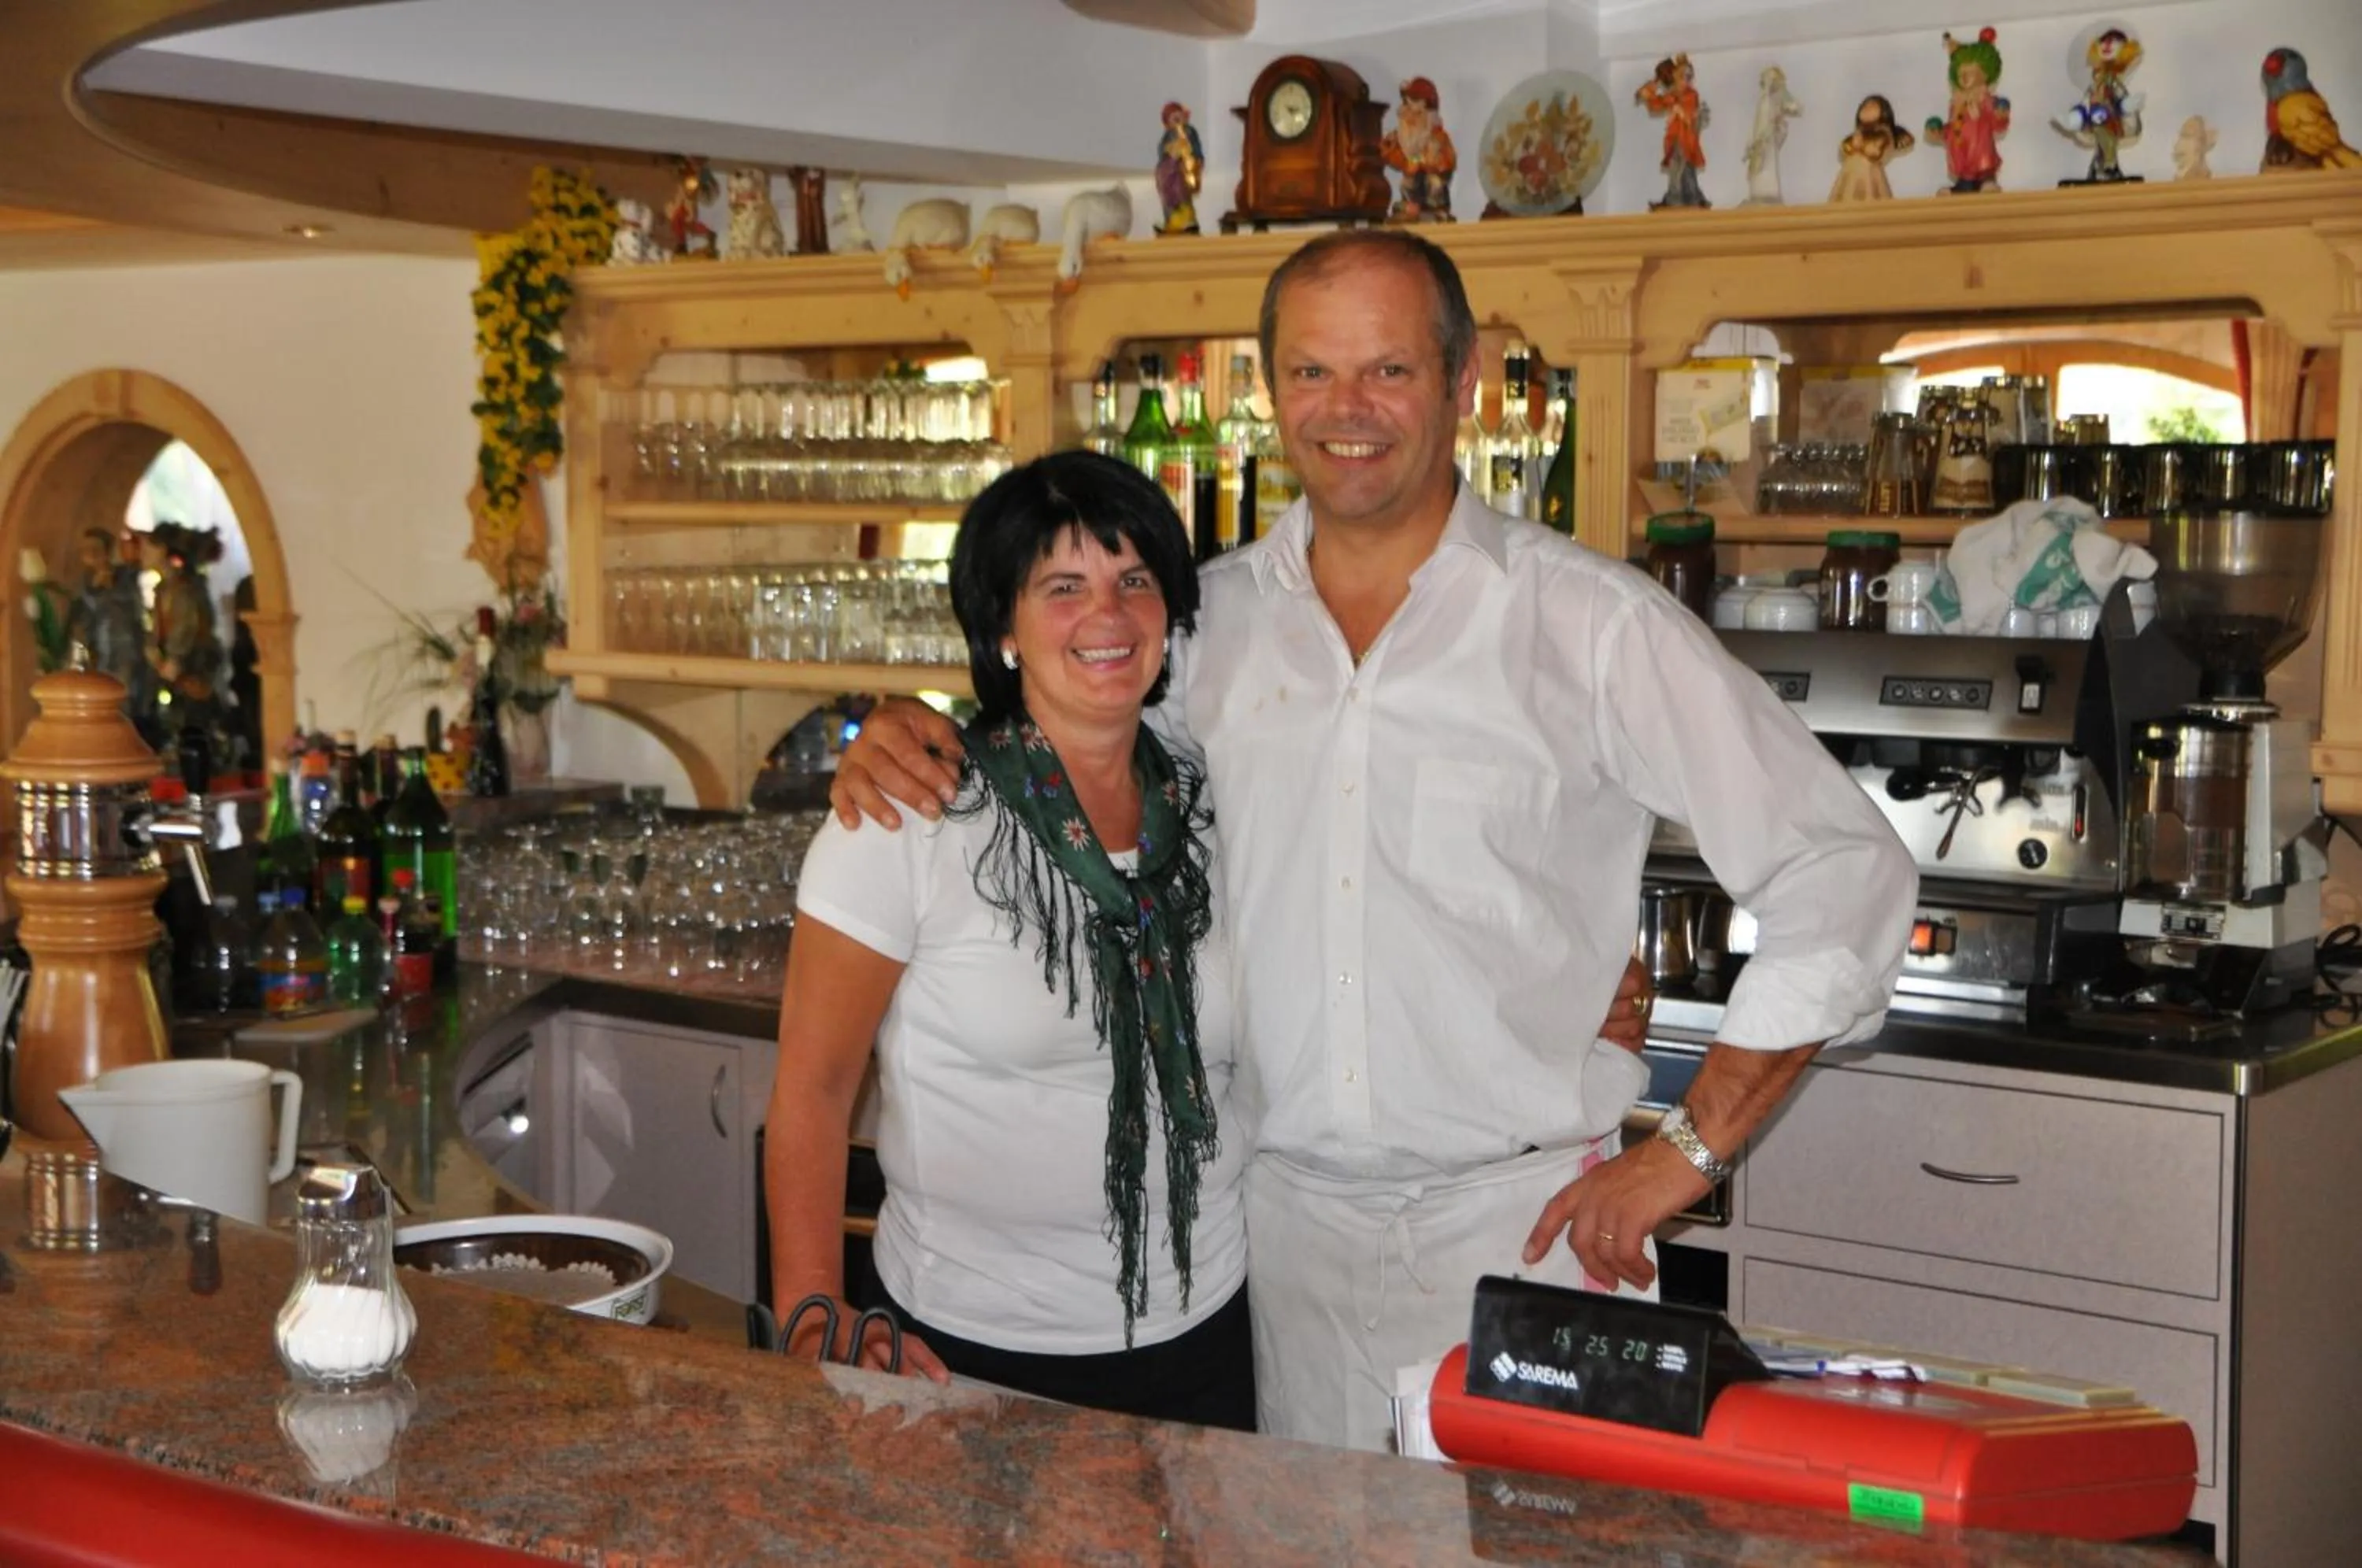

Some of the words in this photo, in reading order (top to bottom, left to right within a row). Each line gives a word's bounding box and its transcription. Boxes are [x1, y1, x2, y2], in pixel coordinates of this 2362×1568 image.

[1585, 1334, 1609, 1357] 25
[1622, 1338, 1648, 1363] 20
[1516, 1359, 1579, 1391] SAREMA
